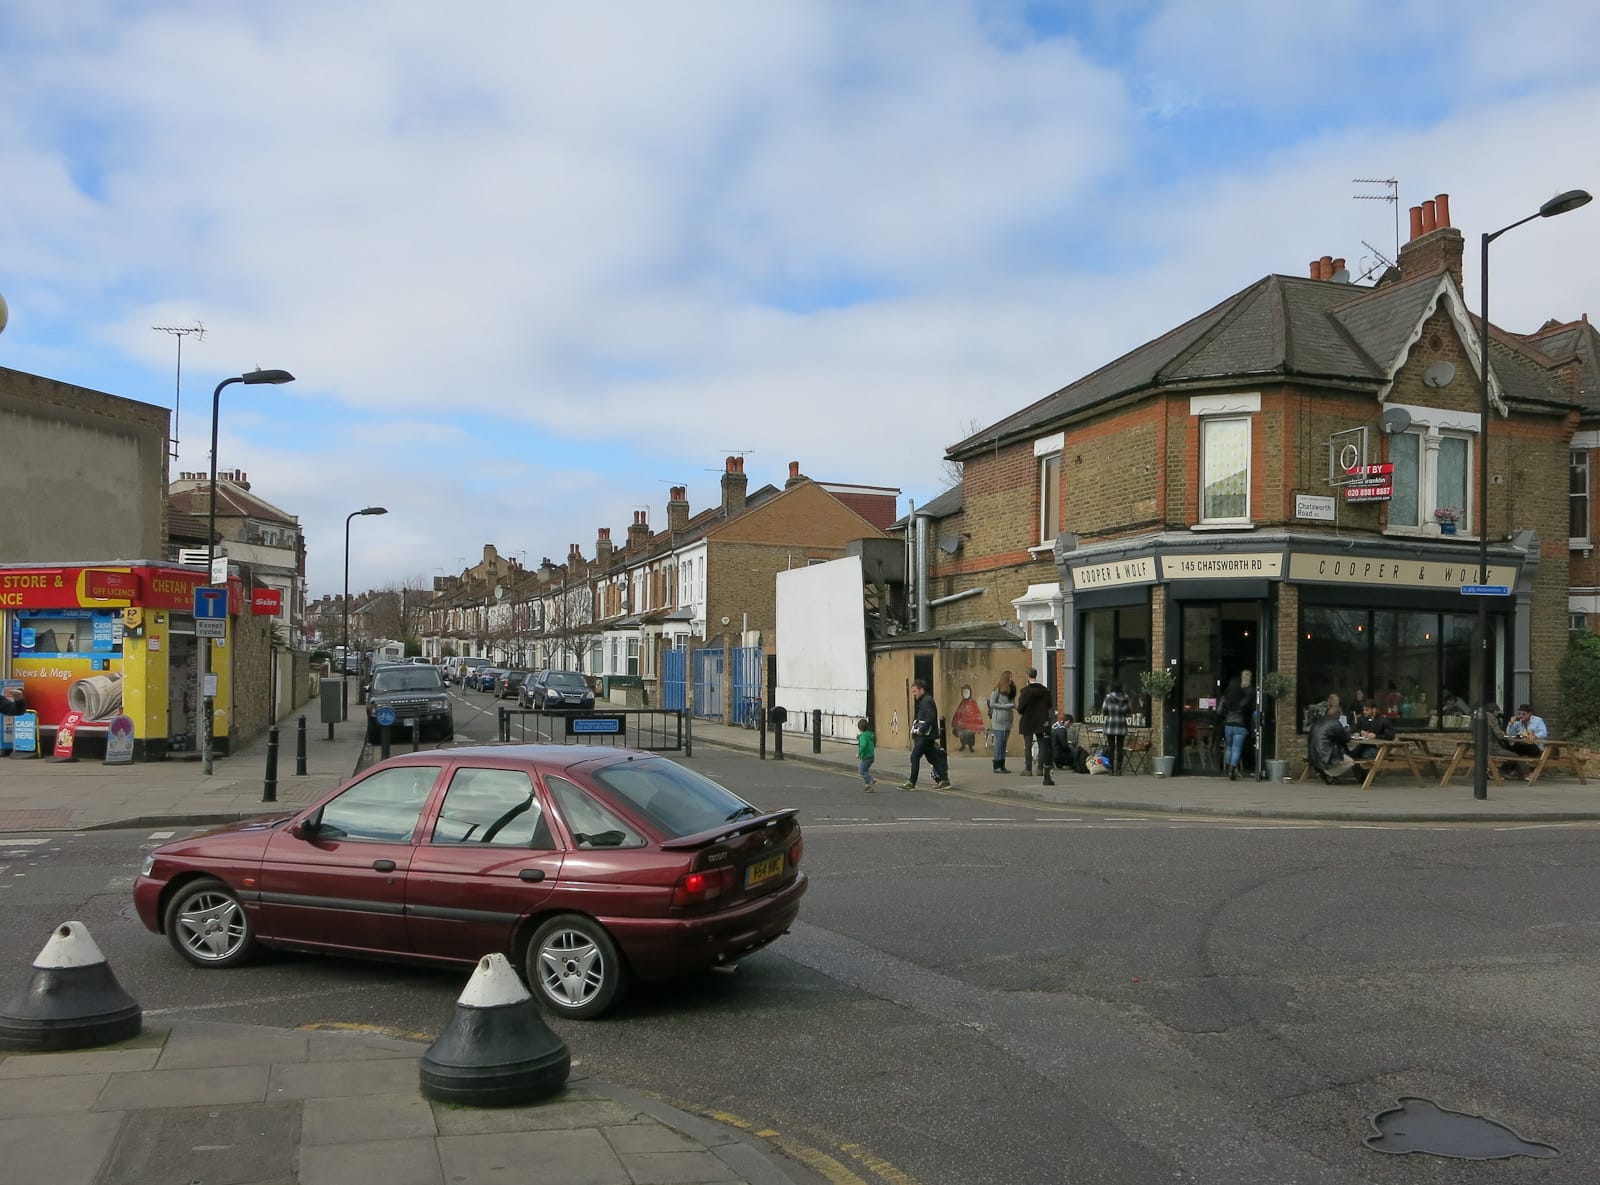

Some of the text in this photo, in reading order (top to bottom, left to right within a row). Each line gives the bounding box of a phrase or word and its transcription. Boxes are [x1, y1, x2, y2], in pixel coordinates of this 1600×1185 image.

[1372, 465, 1382, 473] BY
[1347, 489, 1359, 497] 020
[1298, 502, 1332, 511] Chatsworth
[1298, 509, 1312, 517] Road
[1181, 559, 1262, 572] 145 CHATSWORTH RD
[1319, 560, 1399, 579] COOPER
[1418, 566, 1425, 580] &
[1081, 562, 1147, 584] COOPER & WOLF
[4, 575, 64, 588] STORE &
[152, 578, 187, 594] CHETAN
[93, 586, 136, 597] OFF LICENCE
[199, 621, 223, 630] Except
[15, 668, 72, 680] News & Mags
